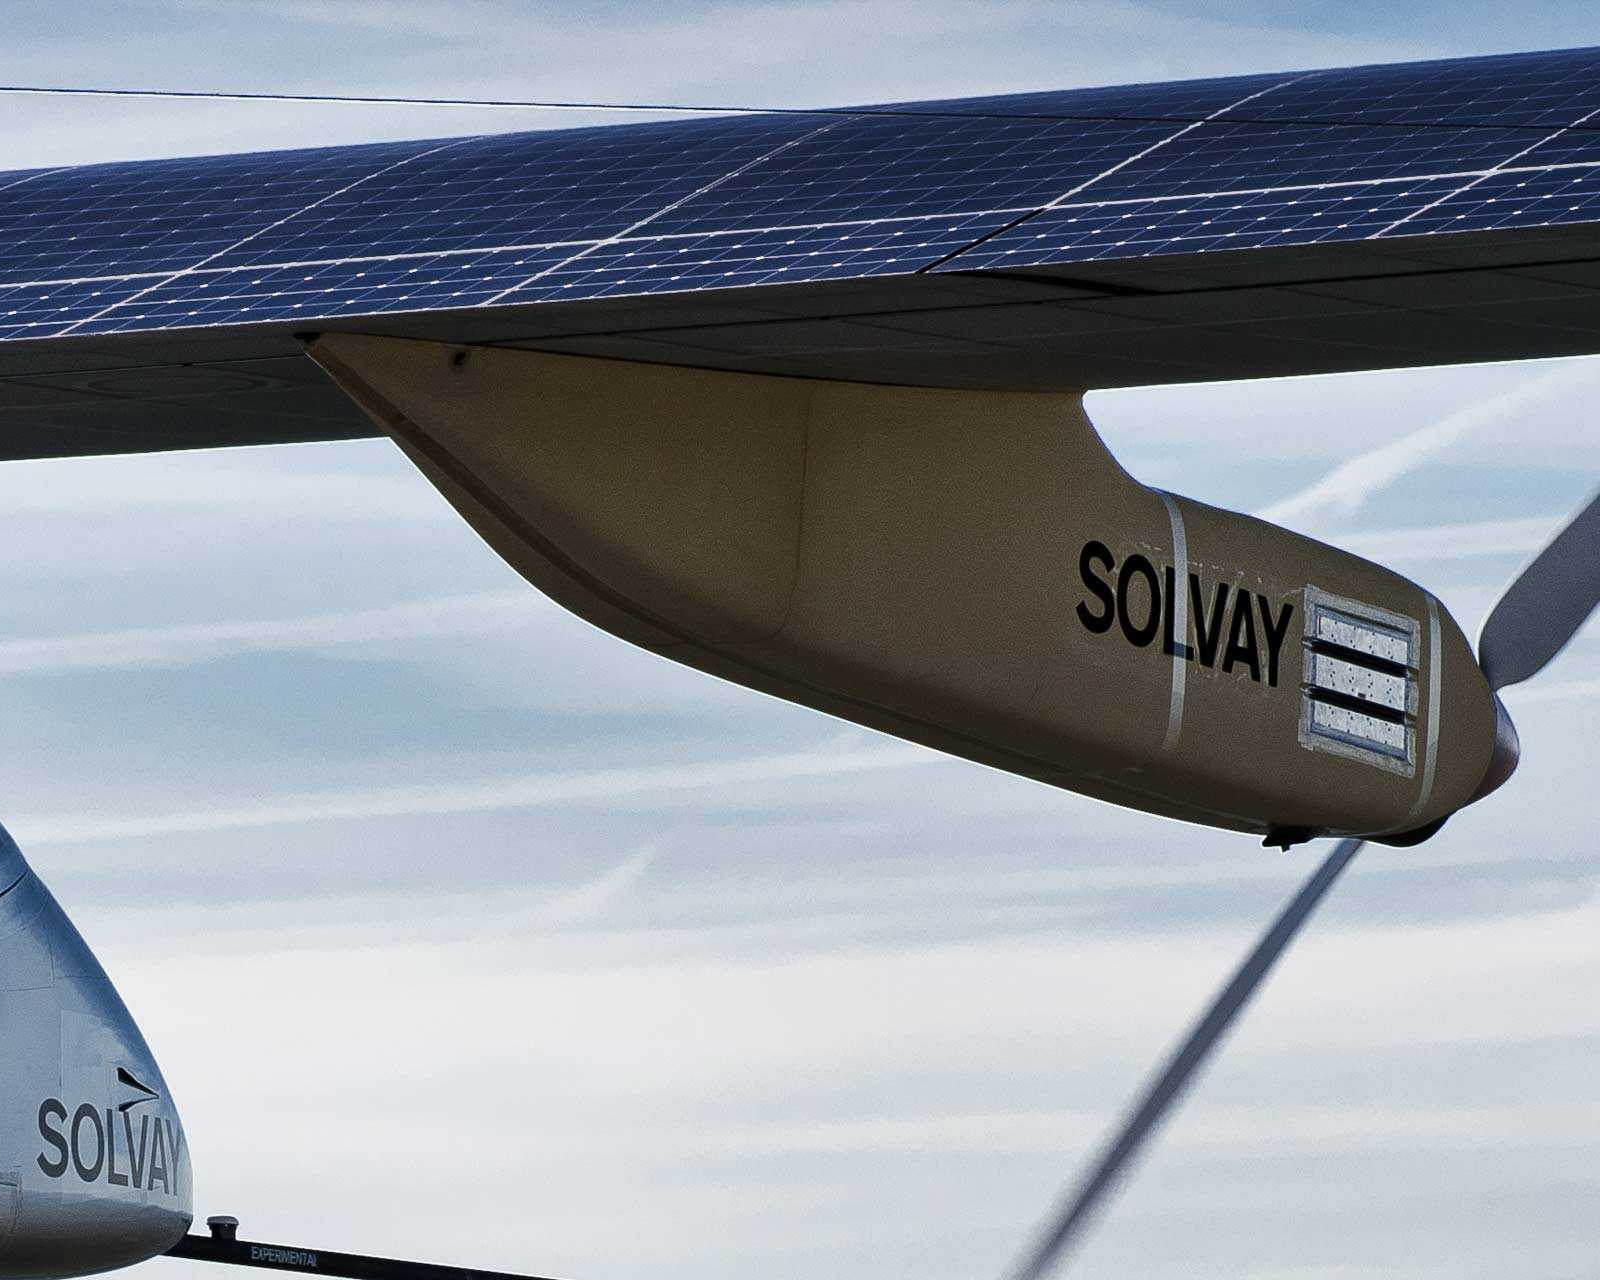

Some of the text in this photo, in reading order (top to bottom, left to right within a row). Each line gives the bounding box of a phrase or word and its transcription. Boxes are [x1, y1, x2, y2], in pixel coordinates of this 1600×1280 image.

[1076, 540, 1294, 688] SOLVAY
[37, 1098, 181, 1196] SOLVAY
[250, 1246, 318, 1267] EXPERIMENTAL
